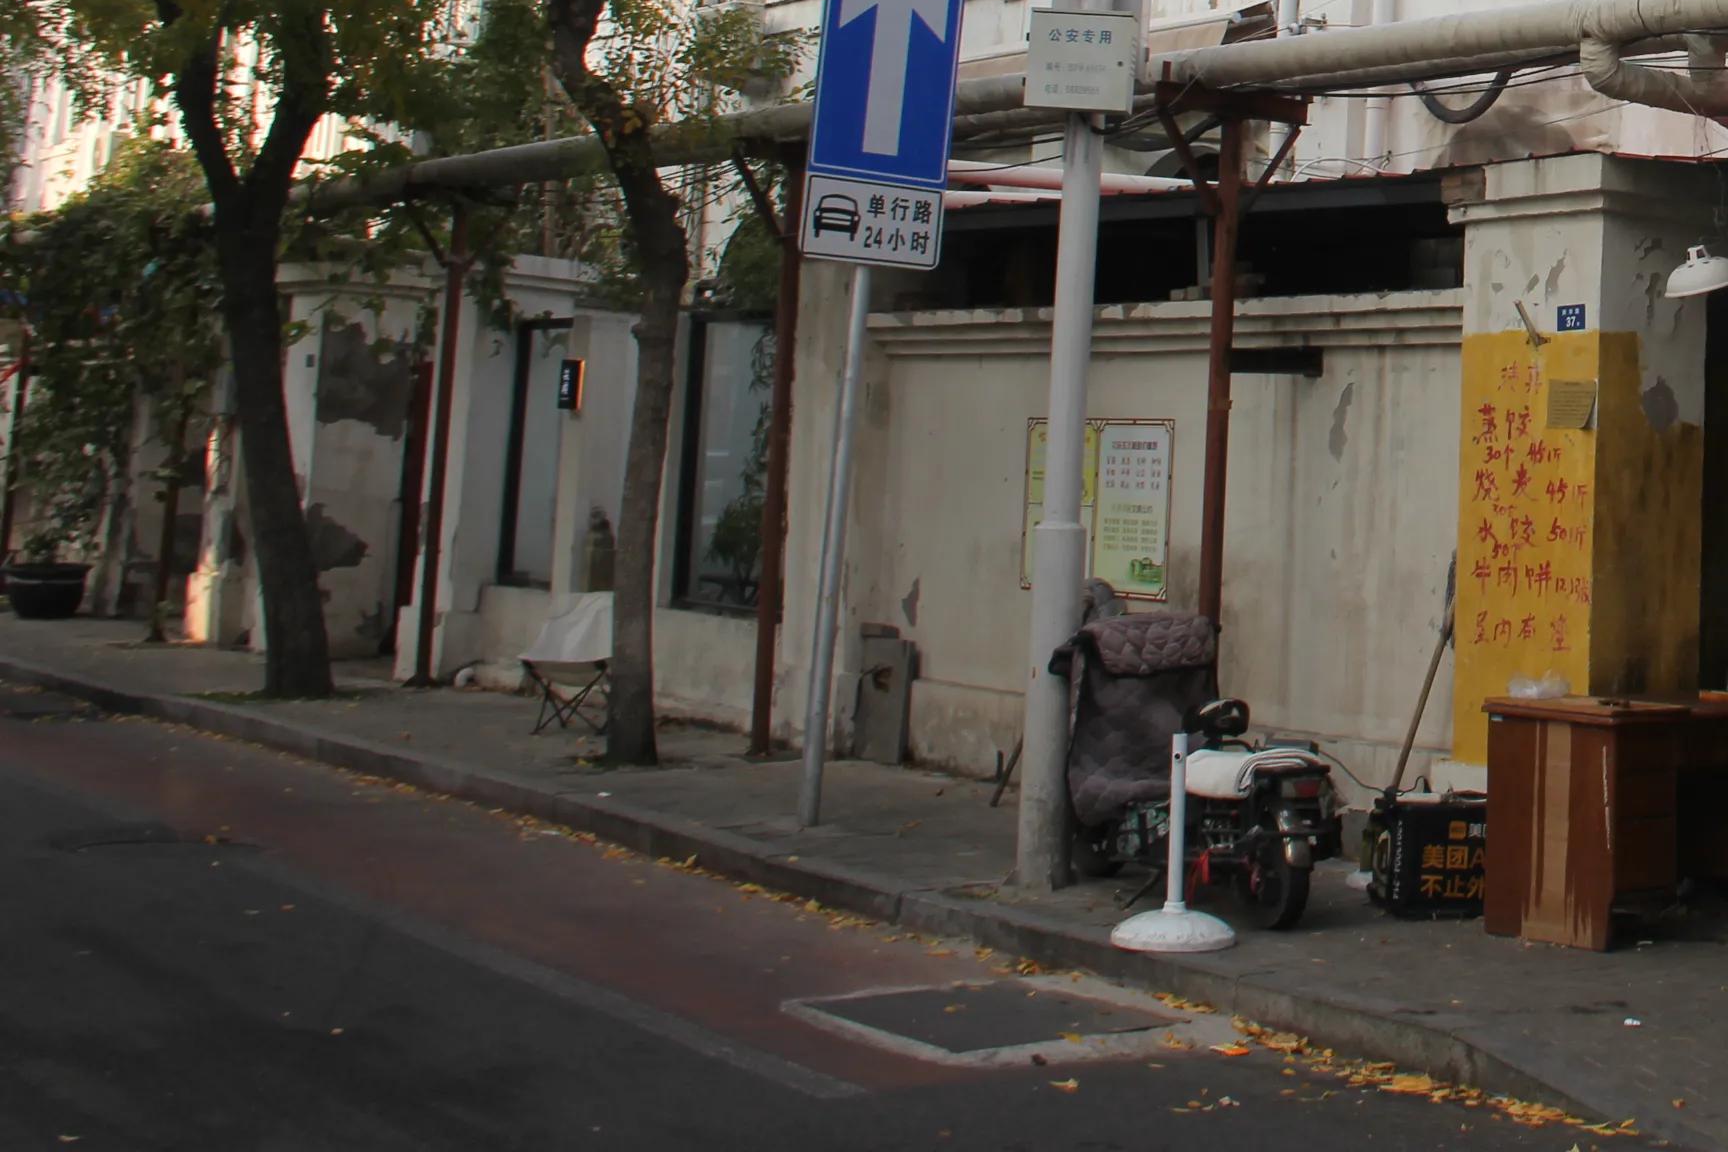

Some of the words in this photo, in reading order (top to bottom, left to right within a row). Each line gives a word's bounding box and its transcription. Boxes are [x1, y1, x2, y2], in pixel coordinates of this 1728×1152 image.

[1048, 28, 1112, 44] 公安专用
[867, 193, 933, 225] 单行路
[864, 225, 931, 255] 24小时
[1477, 514, 1540, 547] 水饺
[1470, 556, 1553, 600] 牛肉饼
